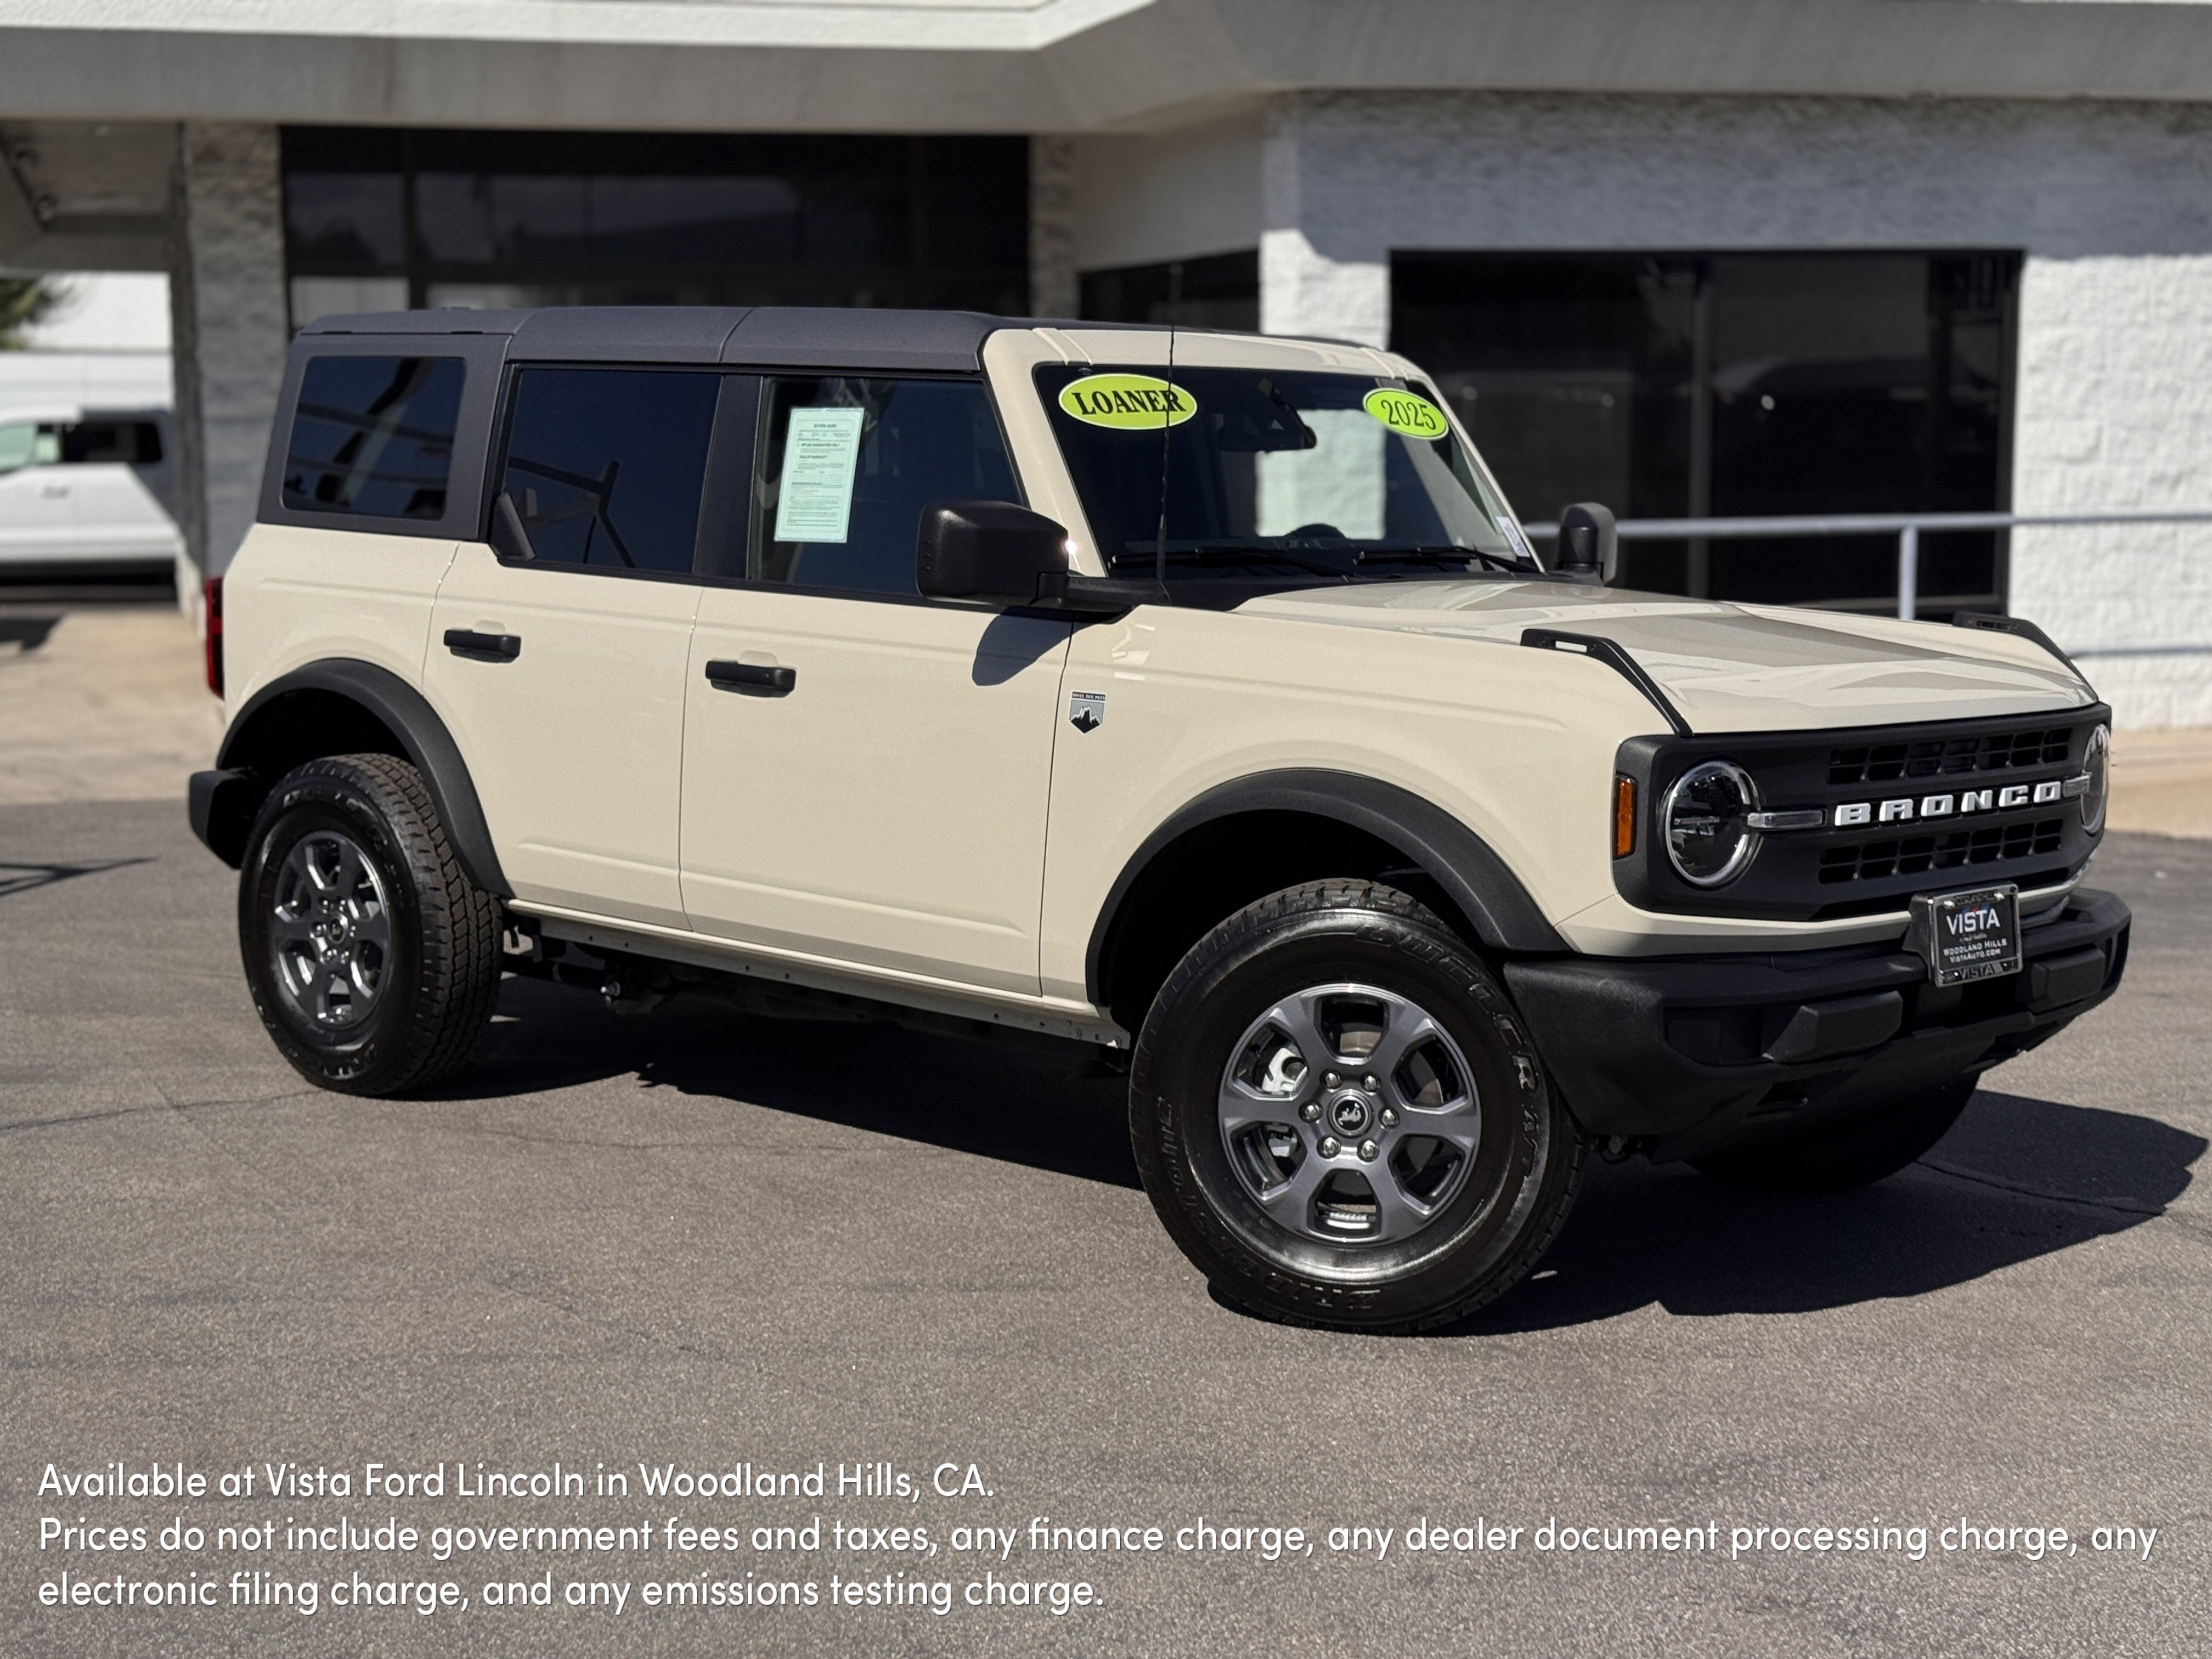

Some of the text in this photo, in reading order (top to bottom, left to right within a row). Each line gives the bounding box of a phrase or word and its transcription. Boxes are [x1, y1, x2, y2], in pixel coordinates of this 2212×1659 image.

[1071, 390, 1187, 415] LOANER
[1380, 399, 1436, 430] 2025
[1835, 781, 2062, 827] BRONCO
[1946, 907, 2001, 935] VISTA
[1943, 943, 1983, 956] WOODLAND
[1984, 938, 2008, 949] HILLS
